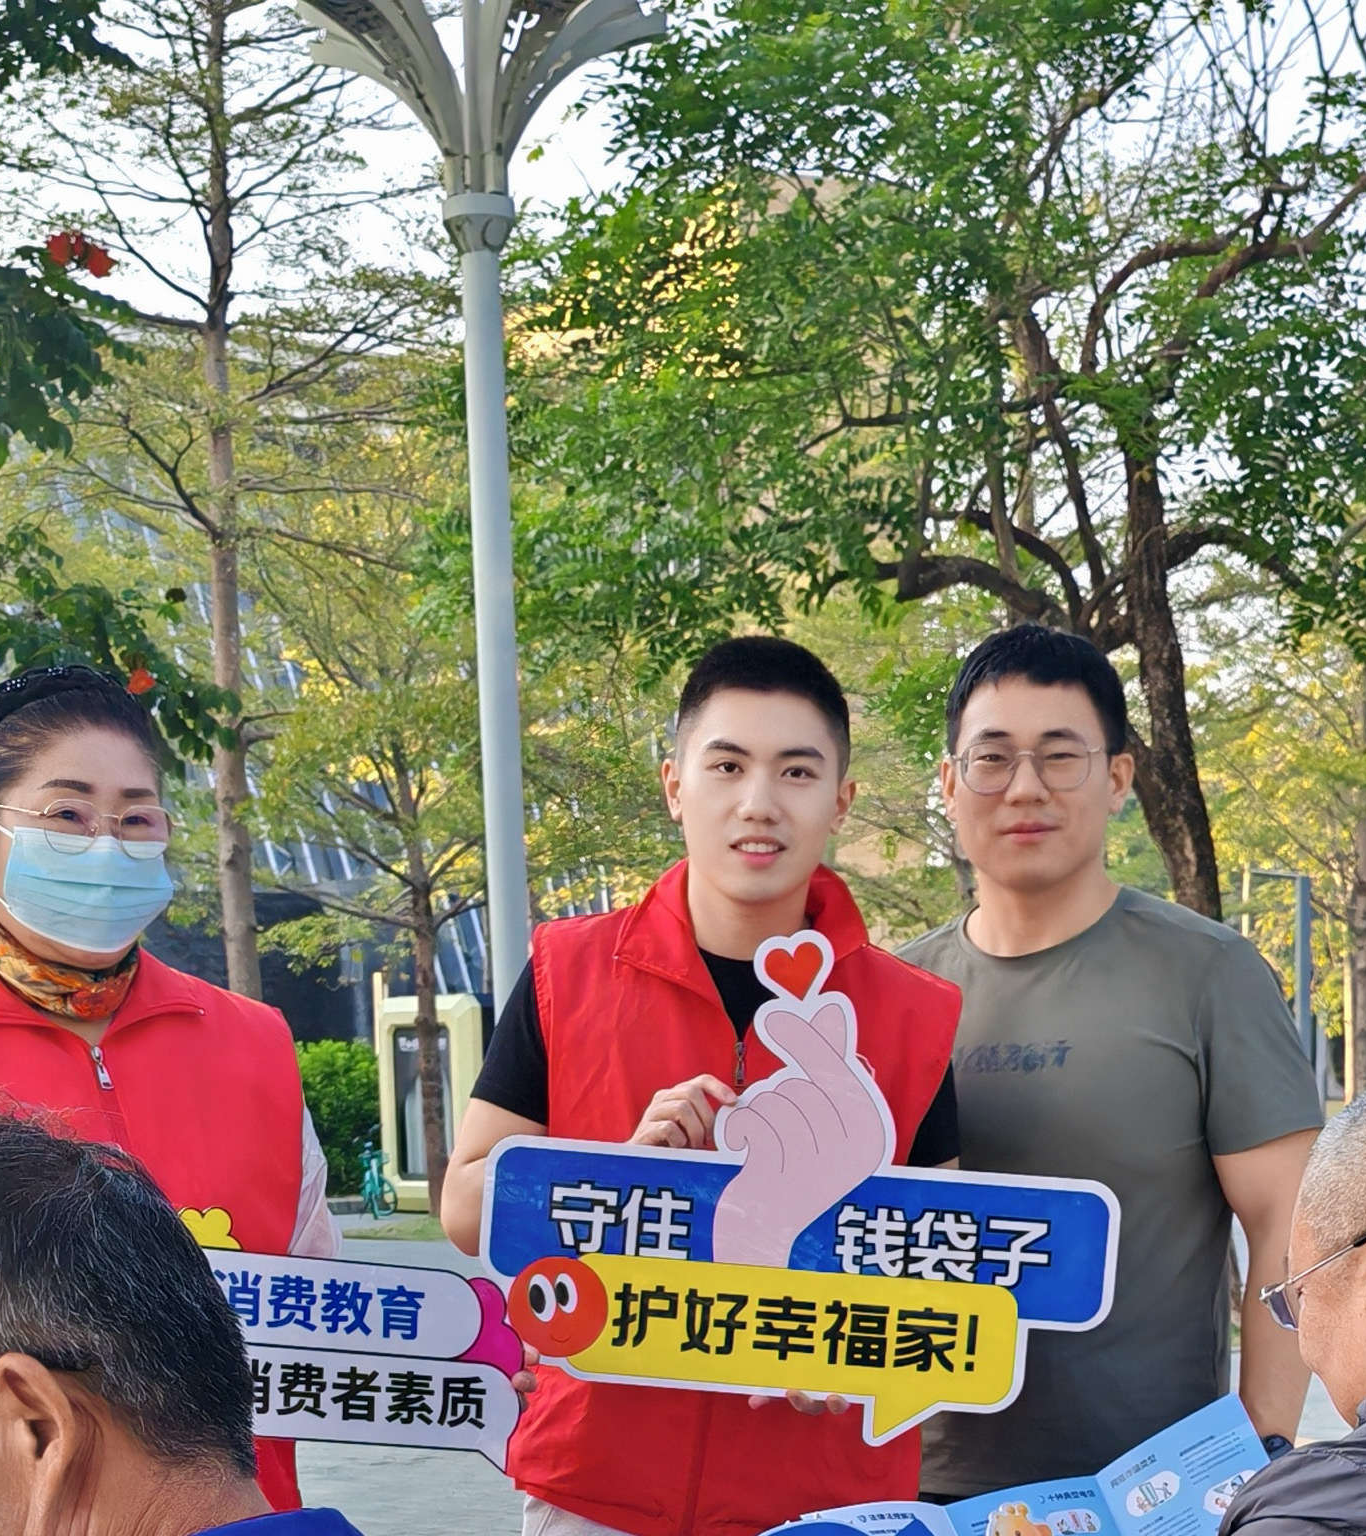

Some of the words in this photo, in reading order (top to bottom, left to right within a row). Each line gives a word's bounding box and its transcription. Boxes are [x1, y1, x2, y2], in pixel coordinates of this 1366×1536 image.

[550, 1181, 694, 1260] 守住
[834, 1205, 1050, 1287] 钱袋子
[610, 1282, 979, 1373] 护好幸福家！
